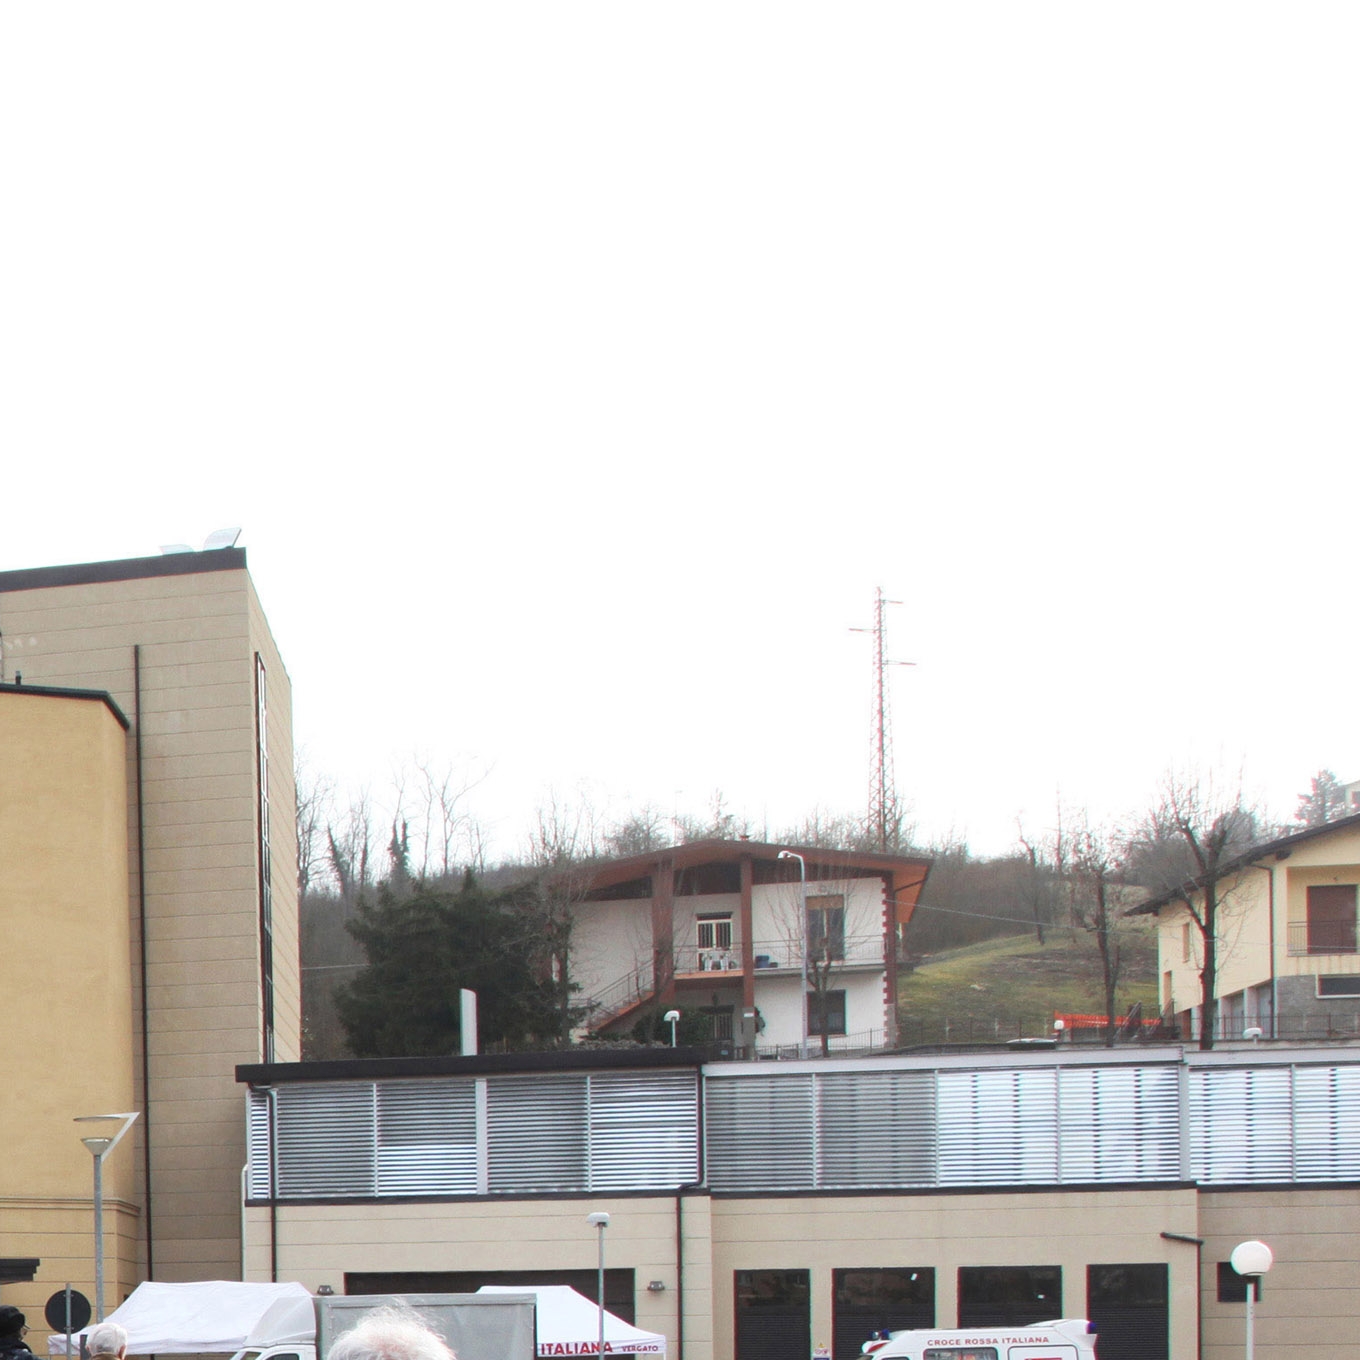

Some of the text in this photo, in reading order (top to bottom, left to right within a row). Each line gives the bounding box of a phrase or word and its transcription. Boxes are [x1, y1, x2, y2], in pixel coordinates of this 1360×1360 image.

[927, 1336, 1049, 1346] CROCE ROSSA ITALIANA
[540, 1341, 613, 1355] ITALIANA
